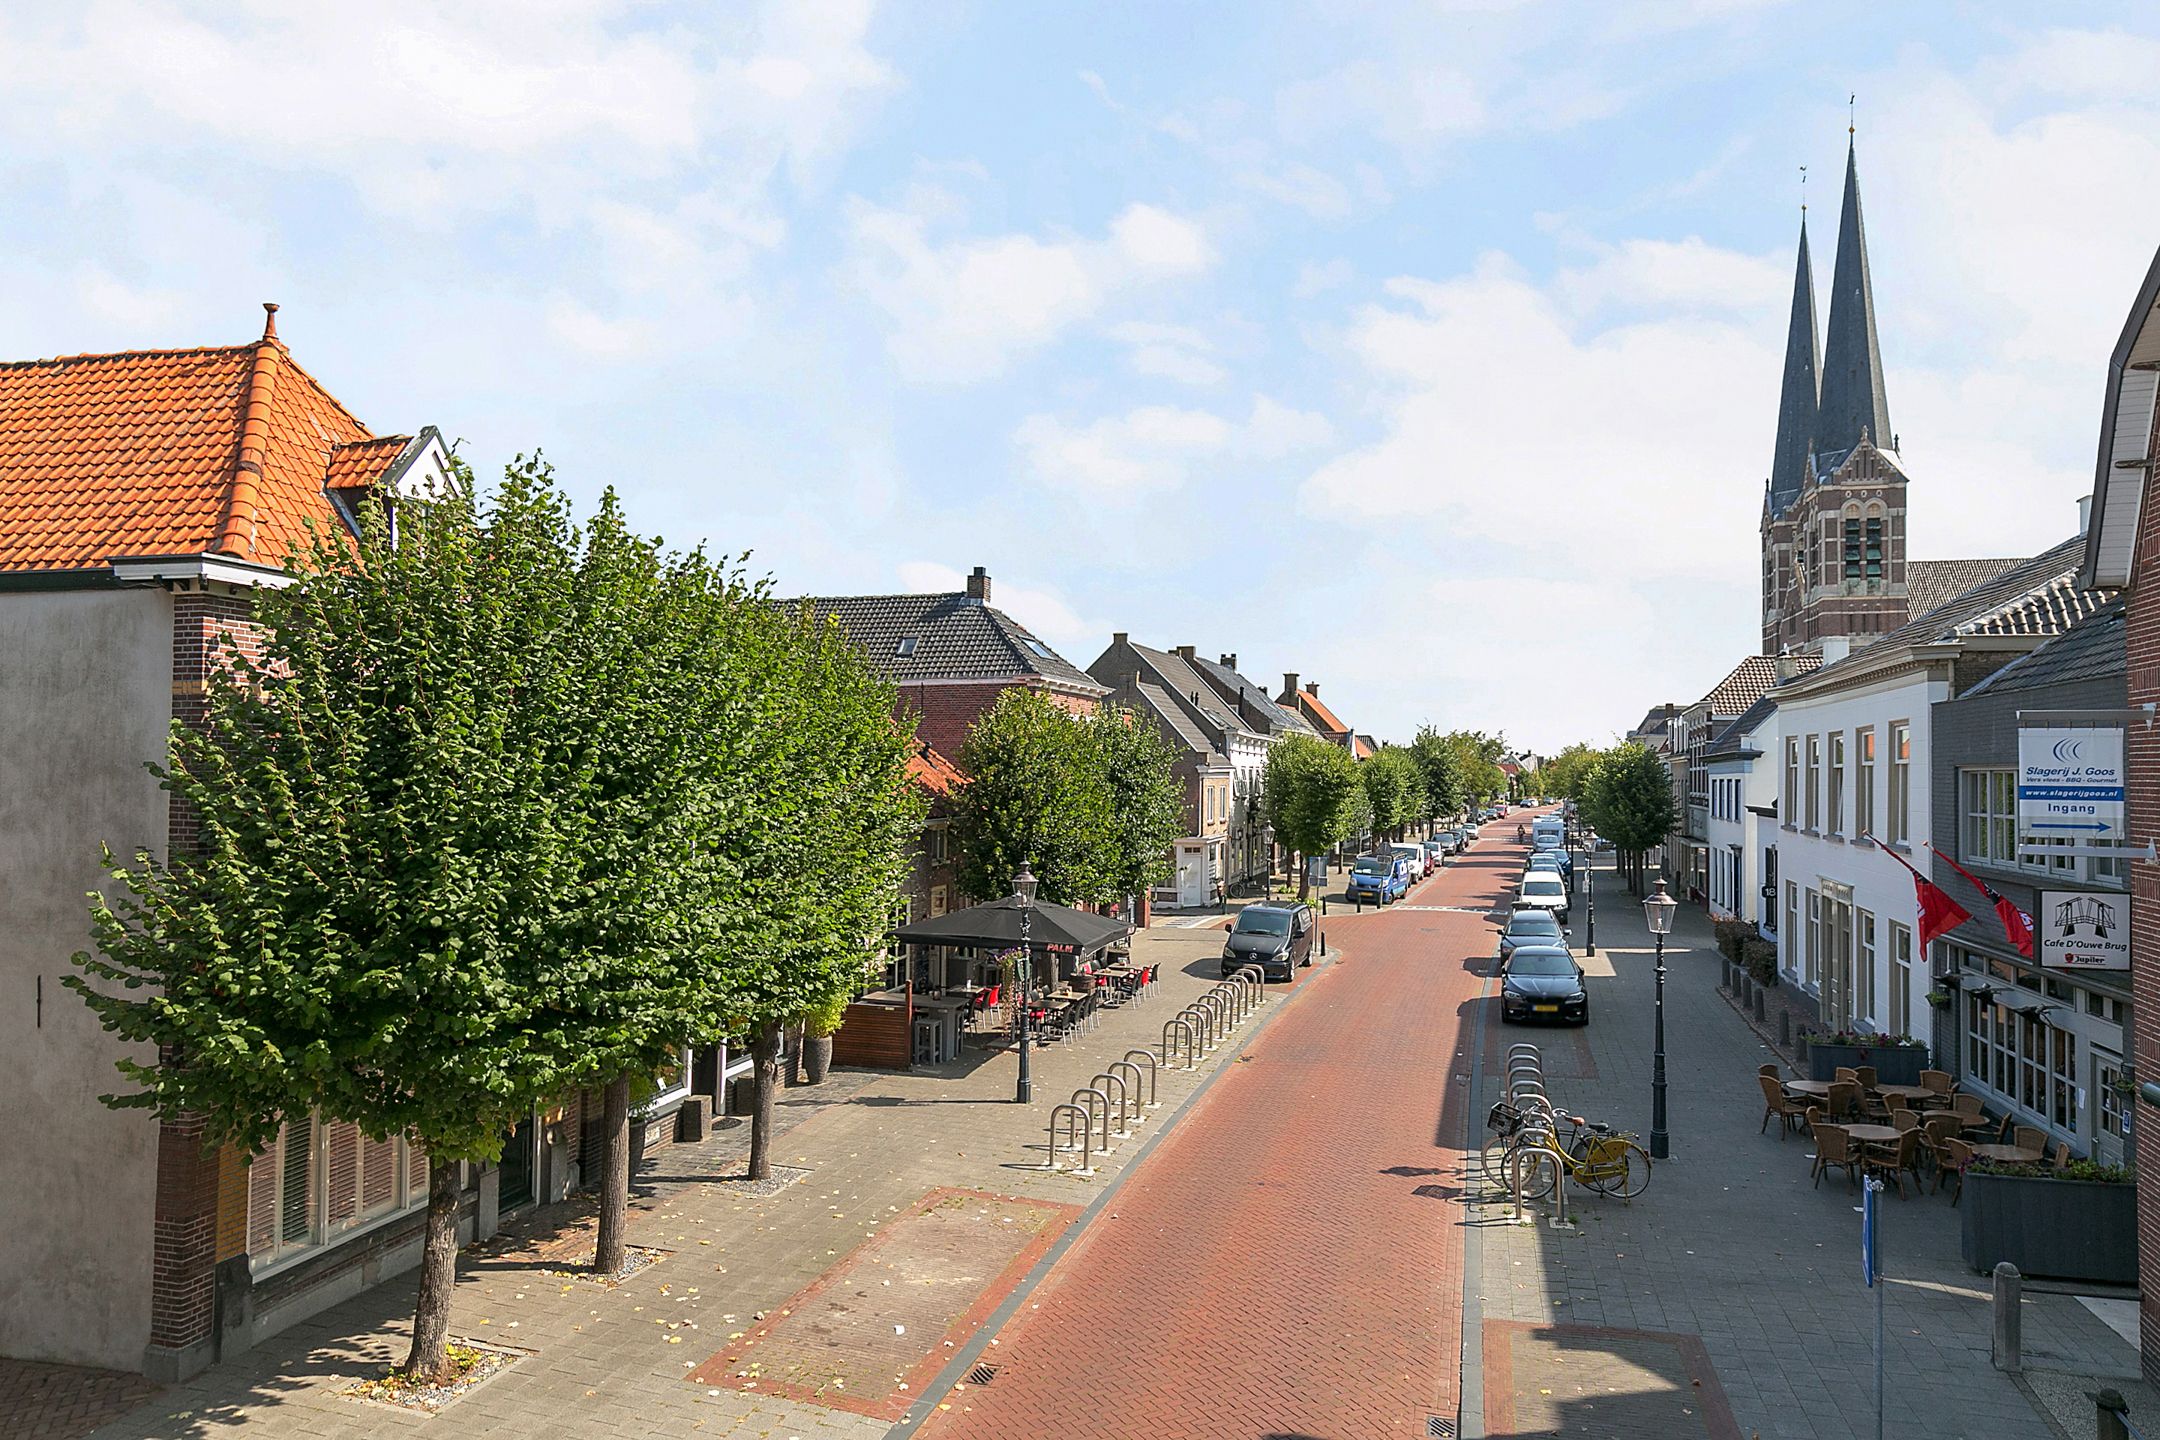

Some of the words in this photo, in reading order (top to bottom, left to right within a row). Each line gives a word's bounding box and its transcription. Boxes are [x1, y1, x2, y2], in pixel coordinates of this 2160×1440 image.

[2026, 766, 2070, 777] Slagerij
[2072, 767, 2081, 776] J.
[2085, 767, 2115, 776] Goos
[2025, 790, 2118, 798] www.slagerijgoos.nl
[2048, 803, 2095, 815] Ingang
[1765, 888, 1776, 897] 18
[1046, 943, 1074, 953] PALM
[2044, 939, 2065, 948] Cafe
[2066, 940, 2103, 950] D'Ouwe
[2104, 942, 2128, 952] Brug
[2075, 956, 2105, 964] Jupiler
